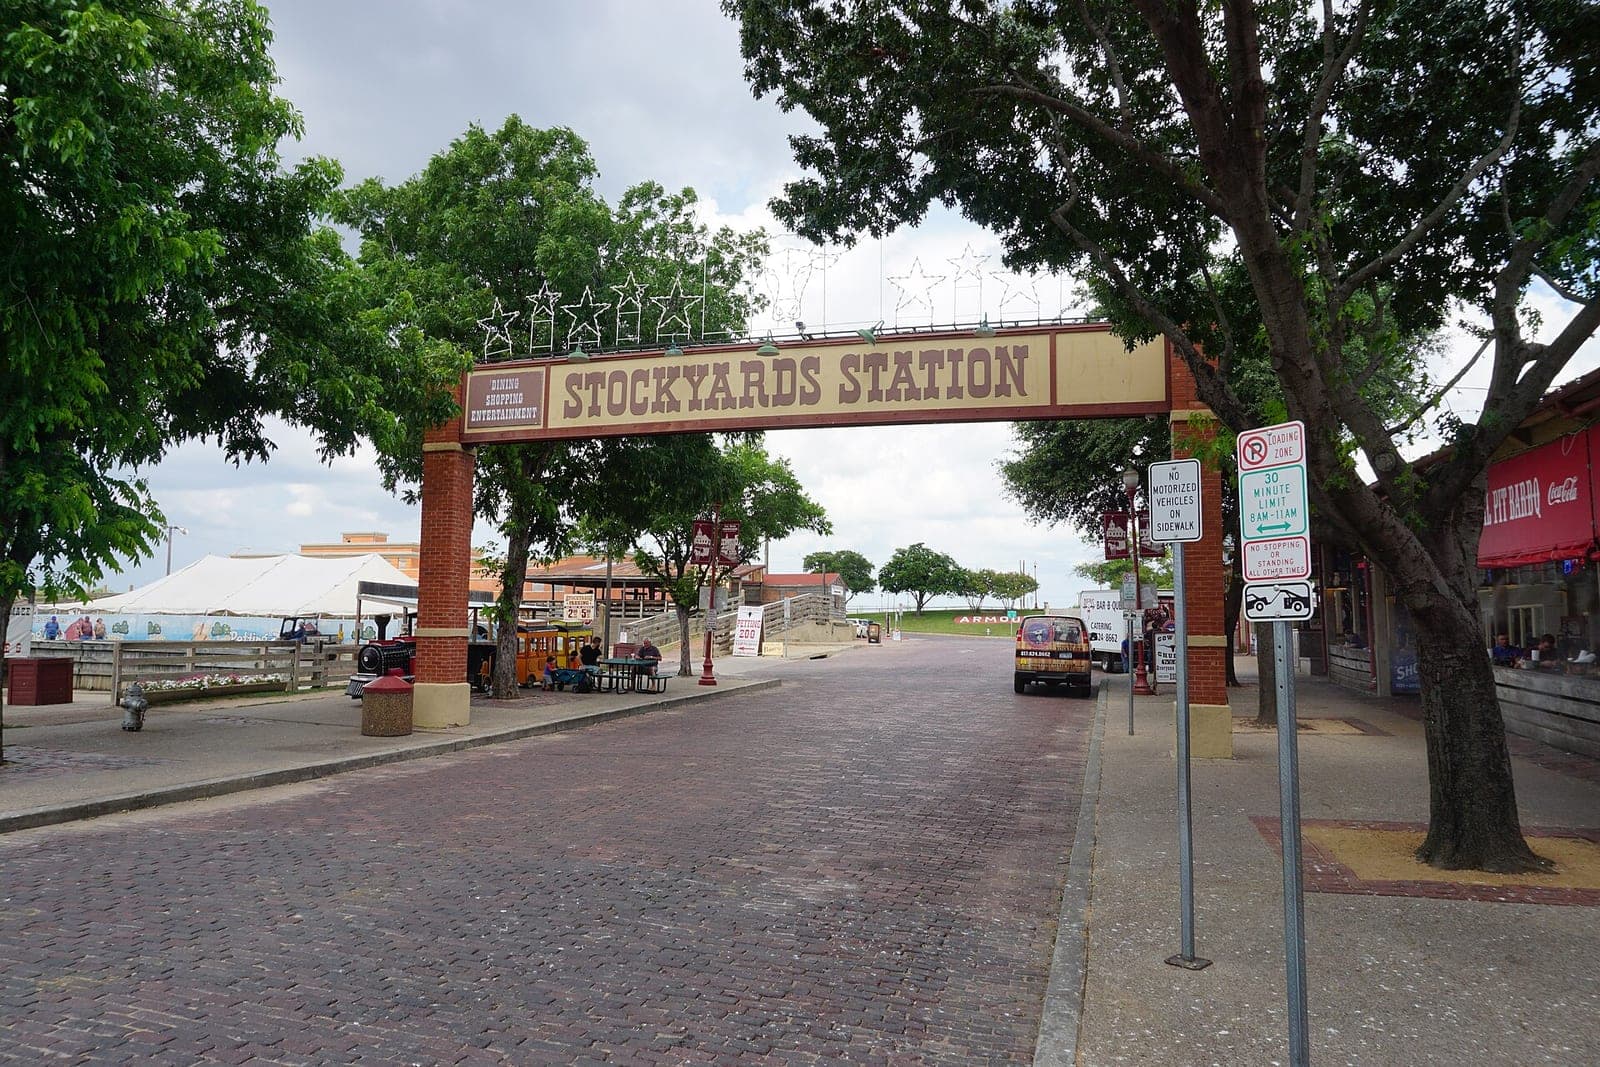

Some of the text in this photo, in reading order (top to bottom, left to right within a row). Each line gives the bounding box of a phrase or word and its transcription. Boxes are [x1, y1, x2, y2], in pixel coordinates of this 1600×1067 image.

[492, 378, 519, 390] DINING
[563, 345, 1029, 419] STOCKYARDS STATION
[485, 393, 523, 406] SHOPPING
[471, 407, 537, 422] ENTERTAINMENT
[1268, 431, 1298, 446] LOADING
[1275, 446, 1293, 459] ZONE
[1169, 471, 1180, 481] NO
[1265, 472, 1279, 484] 30
[1153, 482, 1197, 495] MOTORIZED
[1254, 484, 1290, 497] MINUTE
[1156, 495, 1194, 507] VEHICLES
[1259, 496, 1286, 509] LIMIT
[1492, 487, 1507, 524] PIT
[1170, 509, 1180, 519] ON
[1250, 508, 1297, 523] 8AM-11AM
[1157, 521, 1194, 532] SIDEWALK
[1264, 541, 1300, 551] STOPPING
[1257, 558, 1294, 567] STANDING
[1249, 566, 1305, 577] ALL OTHER TIMES
[1090, 621, 1112, 631] CATERING
